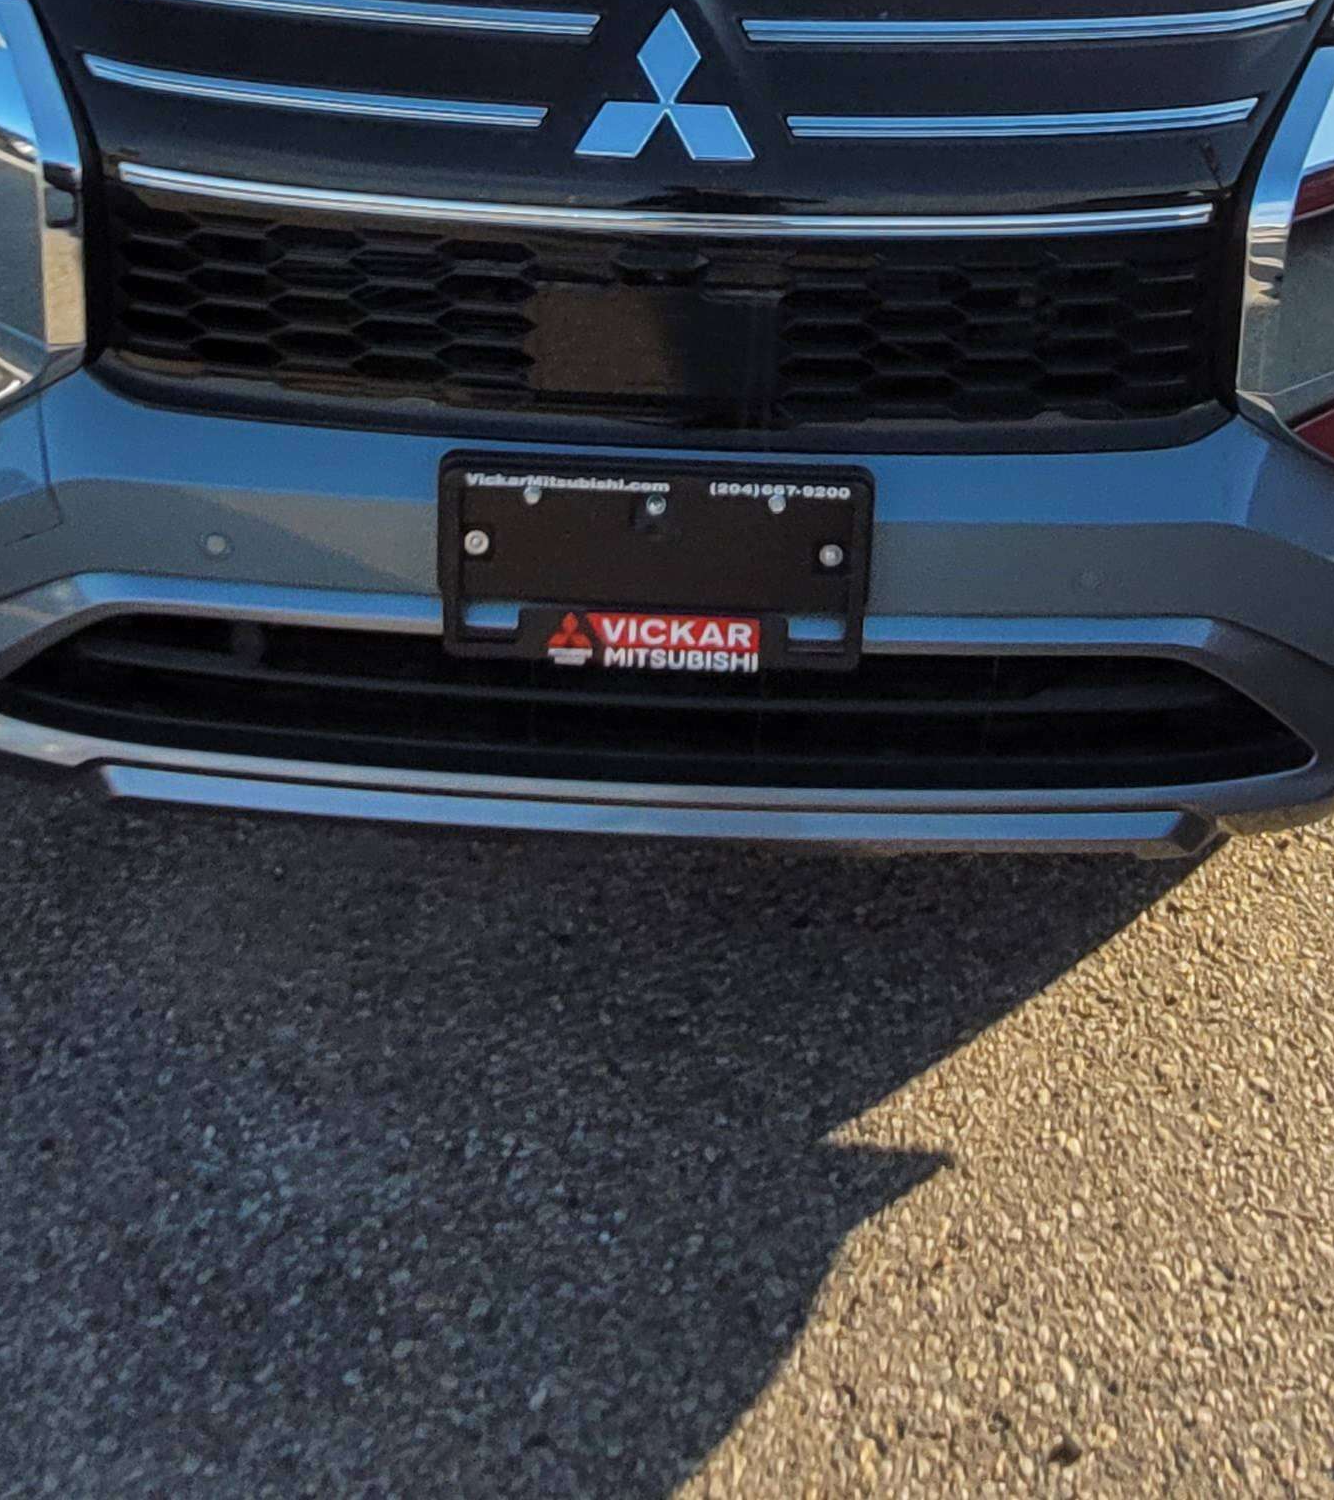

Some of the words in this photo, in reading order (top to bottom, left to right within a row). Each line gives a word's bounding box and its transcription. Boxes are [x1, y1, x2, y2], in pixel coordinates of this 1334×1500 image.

[465, 472, 670, 492] VickarMitsubishi.com
[602, 617, 752, 648] VICKAR
[604, 647, 759, 673] MITSUBISHI
